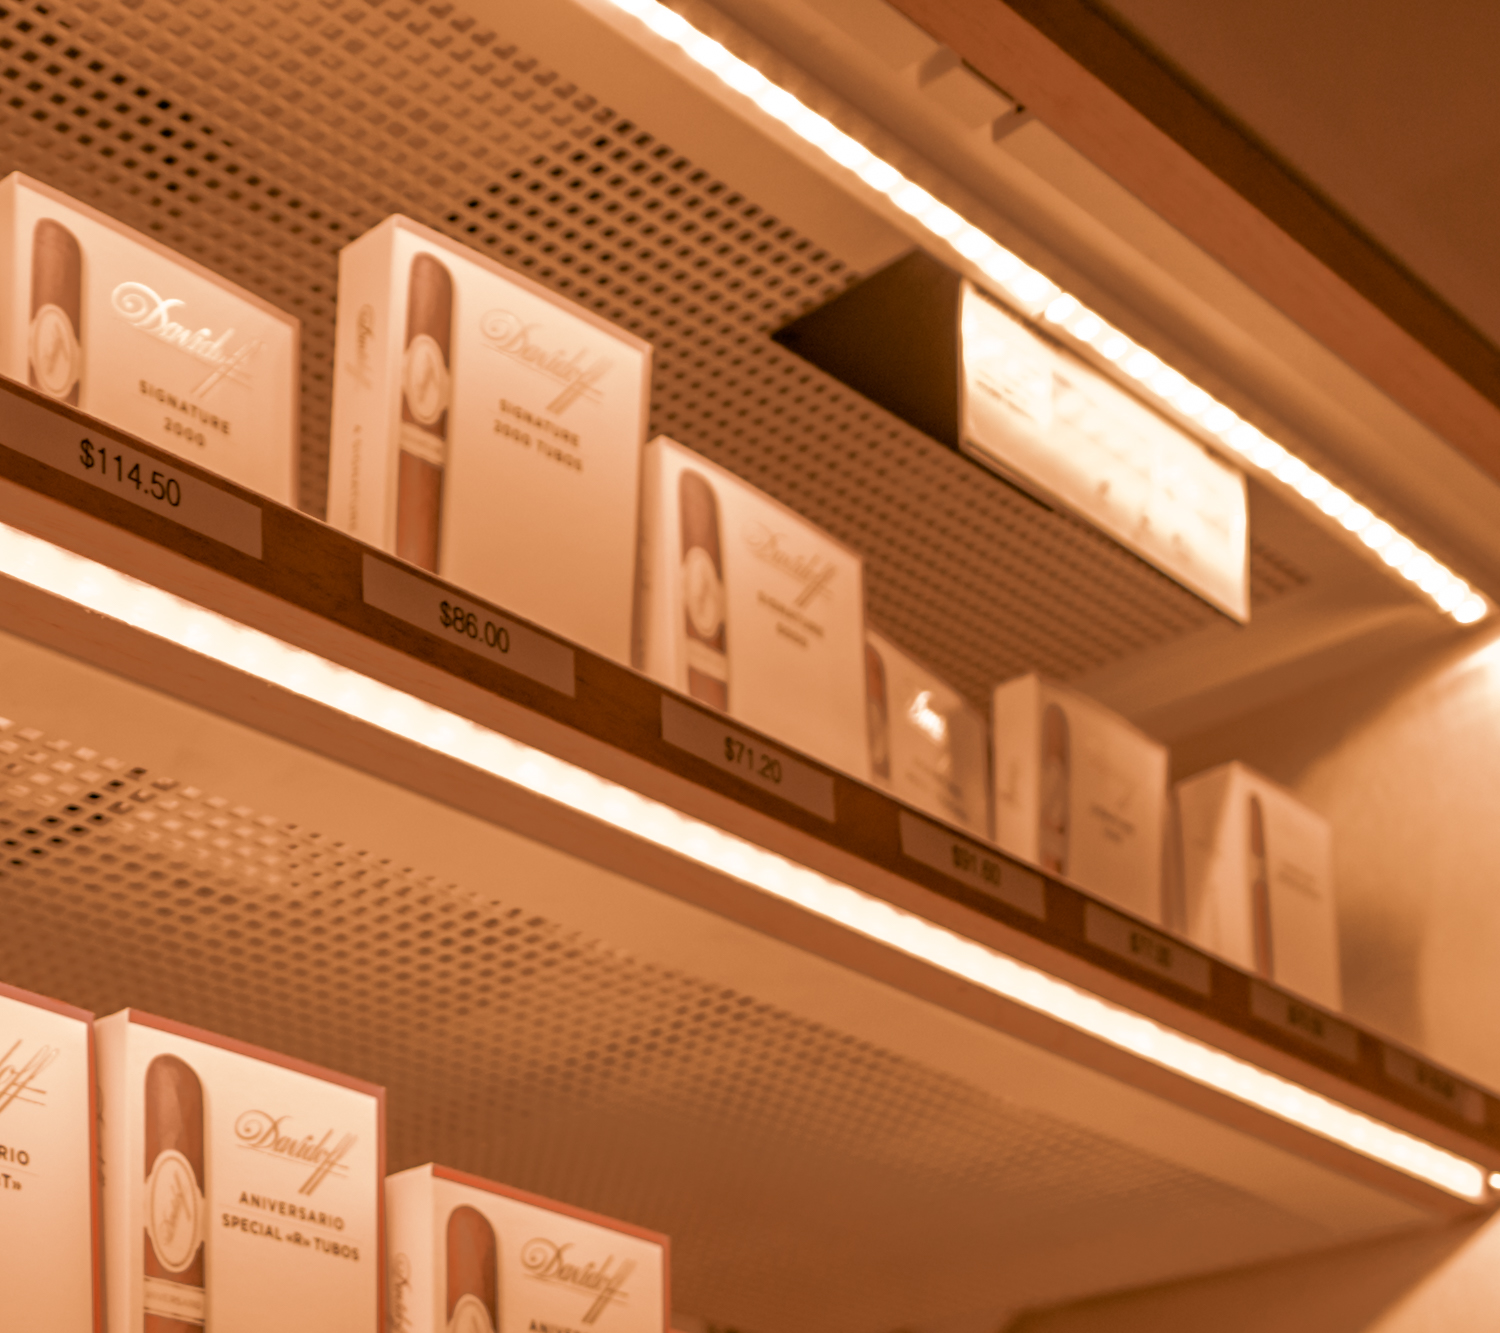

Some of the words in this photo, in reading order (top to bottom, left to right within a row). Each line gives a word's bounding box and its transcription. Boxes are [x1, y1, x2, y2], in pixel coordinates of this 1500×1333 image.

[111, 281, 267, 399] Davidoff
[480, 309, 612, 416] Davidoff
[138, 379, 231, 435] SIGNATURE
[79, 438, 181, 507] $114.50
[440, 600, 510, 653] $86.00
[235, 1109, 358, 1196] Davidoff
[222, 1213, 282, 1242] SPECIAL
[314, 1237, 360, 1262] TUBOS
[239, 1192, 344, 1231] ANIVERSARIO
[520, 1237, 637, 1326] Davidoff
